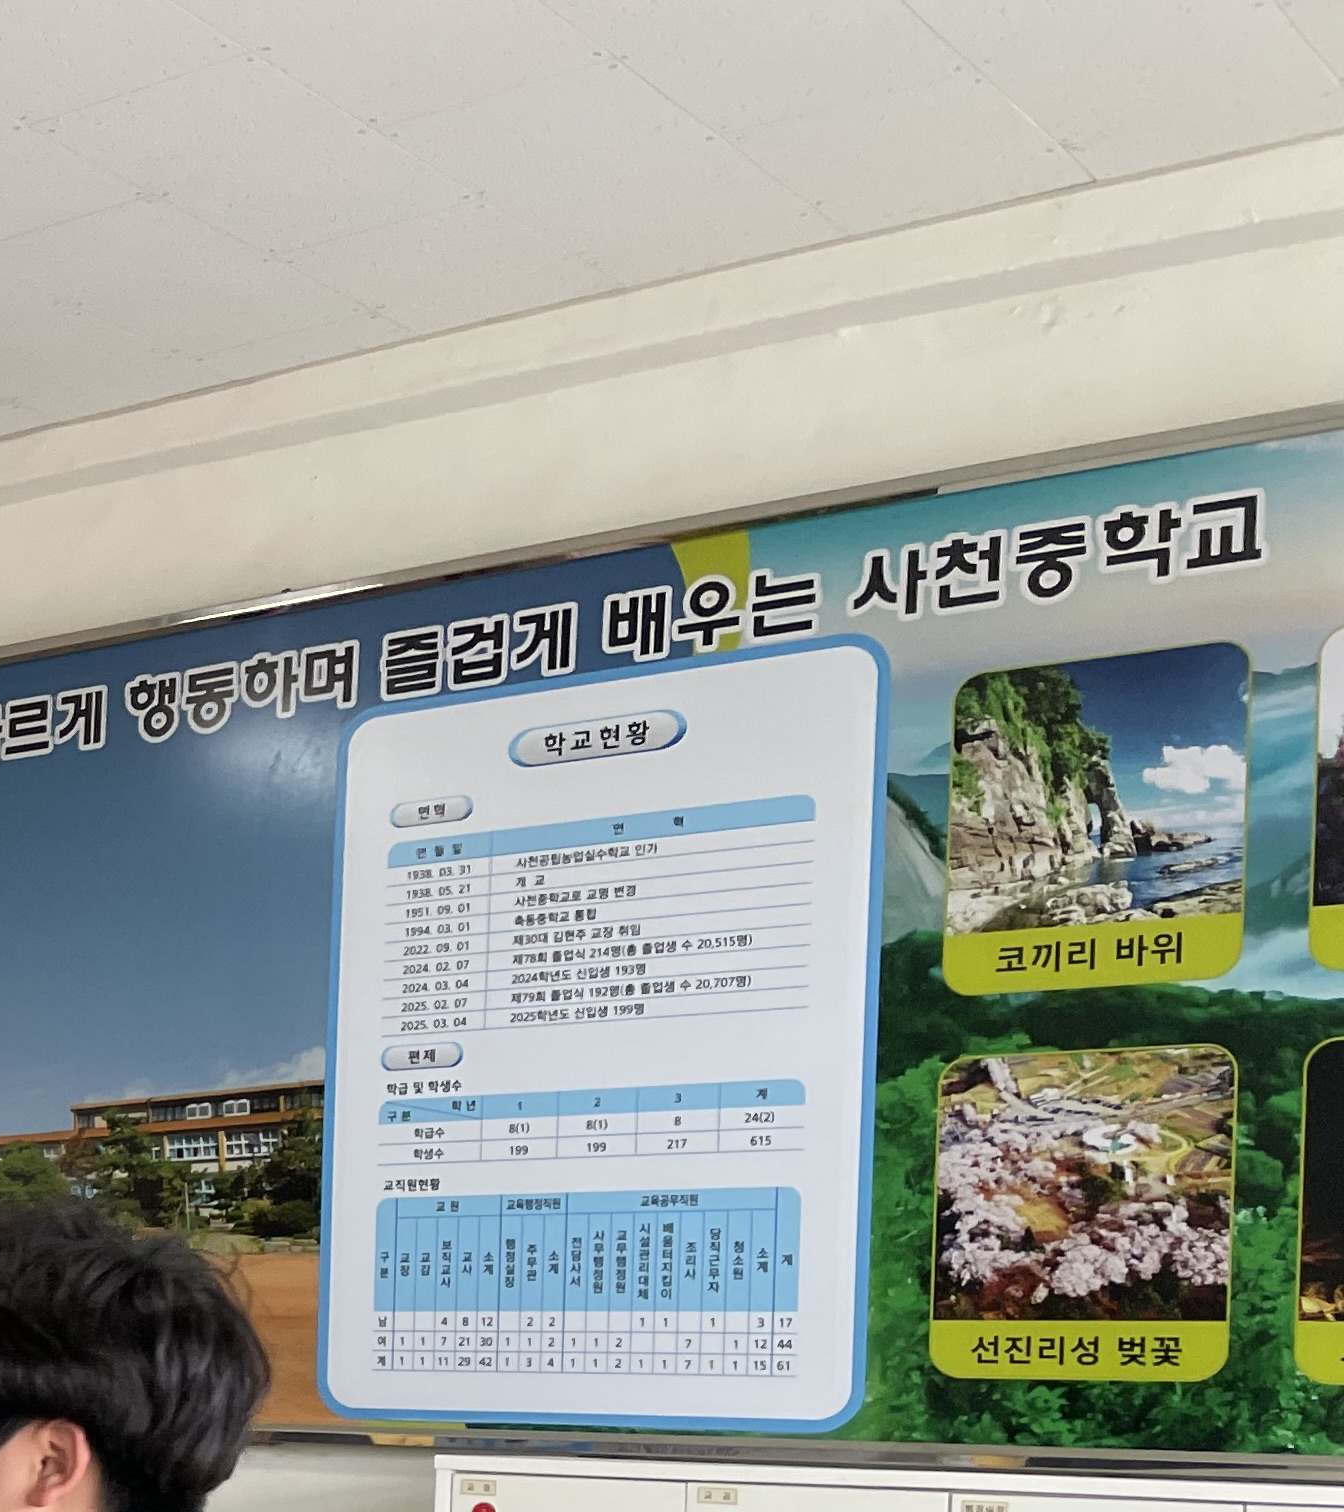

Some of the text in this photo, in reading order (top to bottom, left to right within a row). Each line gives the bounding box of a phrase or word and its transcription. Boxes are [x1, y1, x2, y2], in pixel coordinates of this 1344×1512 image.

[125, 640, 359, 743] 행동하며
[378, 602, 577, 702] 즐겁게
[603, 570, 819, 659] 배우는
[848, 489, 1266, 621] 사천중학교
[544, 719, 650, 757] 학교현황
[635, 843, 657, 856] 인가
[407, 865, 471, 880] 1938. 03. 31
[407, 884, 471, 899] 1938. 05. 21
[515, 885, 636, 907] 사천중학교로 교명 변경
[406, 903, 470, 918] 1951. 09. 01
[406, 922, 470, 937] 1994. 03. 01
[513, 924, 641, 945] 제30대 김현주 교장 취임
[403, 941, 469, 956] 2022. 09. 01
[513, 934, 753, 964] 제78회 졸업식 214명(총 졸업생 수 20,515명)
[995, 931, 1184, 974] 코끼리 바위
[403, 960, 469, 975] 2024. 02. 07
[512, 963, 646, 984] 2024학년도 신입생 193명
[402, 979, 469, 994] 2024. 03. 04
[511, 975, 751, 1004] 제79회 졸업식 192명(총 졸업생 수 20,707명)
[401, 998, 467, 1012] 2025. 02. 07
[510, 1003, 644, 1023] 2025학년도 신입생 199명
[401, 1017, 467, 1031] 2025. 03. 04
[407, 1048, 437, 1066] 편제
[387, 1080, 462, 1095] 학급 및 학생수
[594, 1097, 601, 1107] 2
[414, 1112, 775, 1139] 학급수 8(1) 8(1) 8 24(2)
[414, 1136, 771, 1160] 학생수 199 199 217 615
[384, 1178, 440, 1191] 교직원현황
[507, 1198, 561, 1210] 교육행정직원
[640, 1194, 699, 1207] 교육공무직원
[400, 1253, 410, 1276] 교장
[421, 1252, 430, 1276] 교감
[440, 1240, 451, 1288] 보직교사
[462, 1251, 472, 1275] 교사
[483, 1252, 494, 1274] 소계
[527, 1244, 537, 1281] 주무관
[548, 1251, 559, 1274] 소계
[570, 1237, 582, 1287] 전담사서
[593, 1231, 604, 1294] 사무행정원
[616, 1230, 627, 1293] 교무행정원
[637, 1223, 651, 1300] 시설관리대체
[661, 1223, 674, 1300] 배움터지킴이
[684, 1242, 697, 1279] 조리사
[708, 1228, 721, 1293] 당직근무자
[733, 1241, 744, 1280] 청소원
[757, 1248, 768, 1273] 소계
[781, 1254, 793, 1266] 계
[482, 1317, 792, 1327] 12 17
[458, 1337, 792, 1349] 21 30 12 44
[971, 1336, 1183, 1366] 선진리성 벚꽃
[438, 1357, 790, 1370] 11 29 42 15 61
